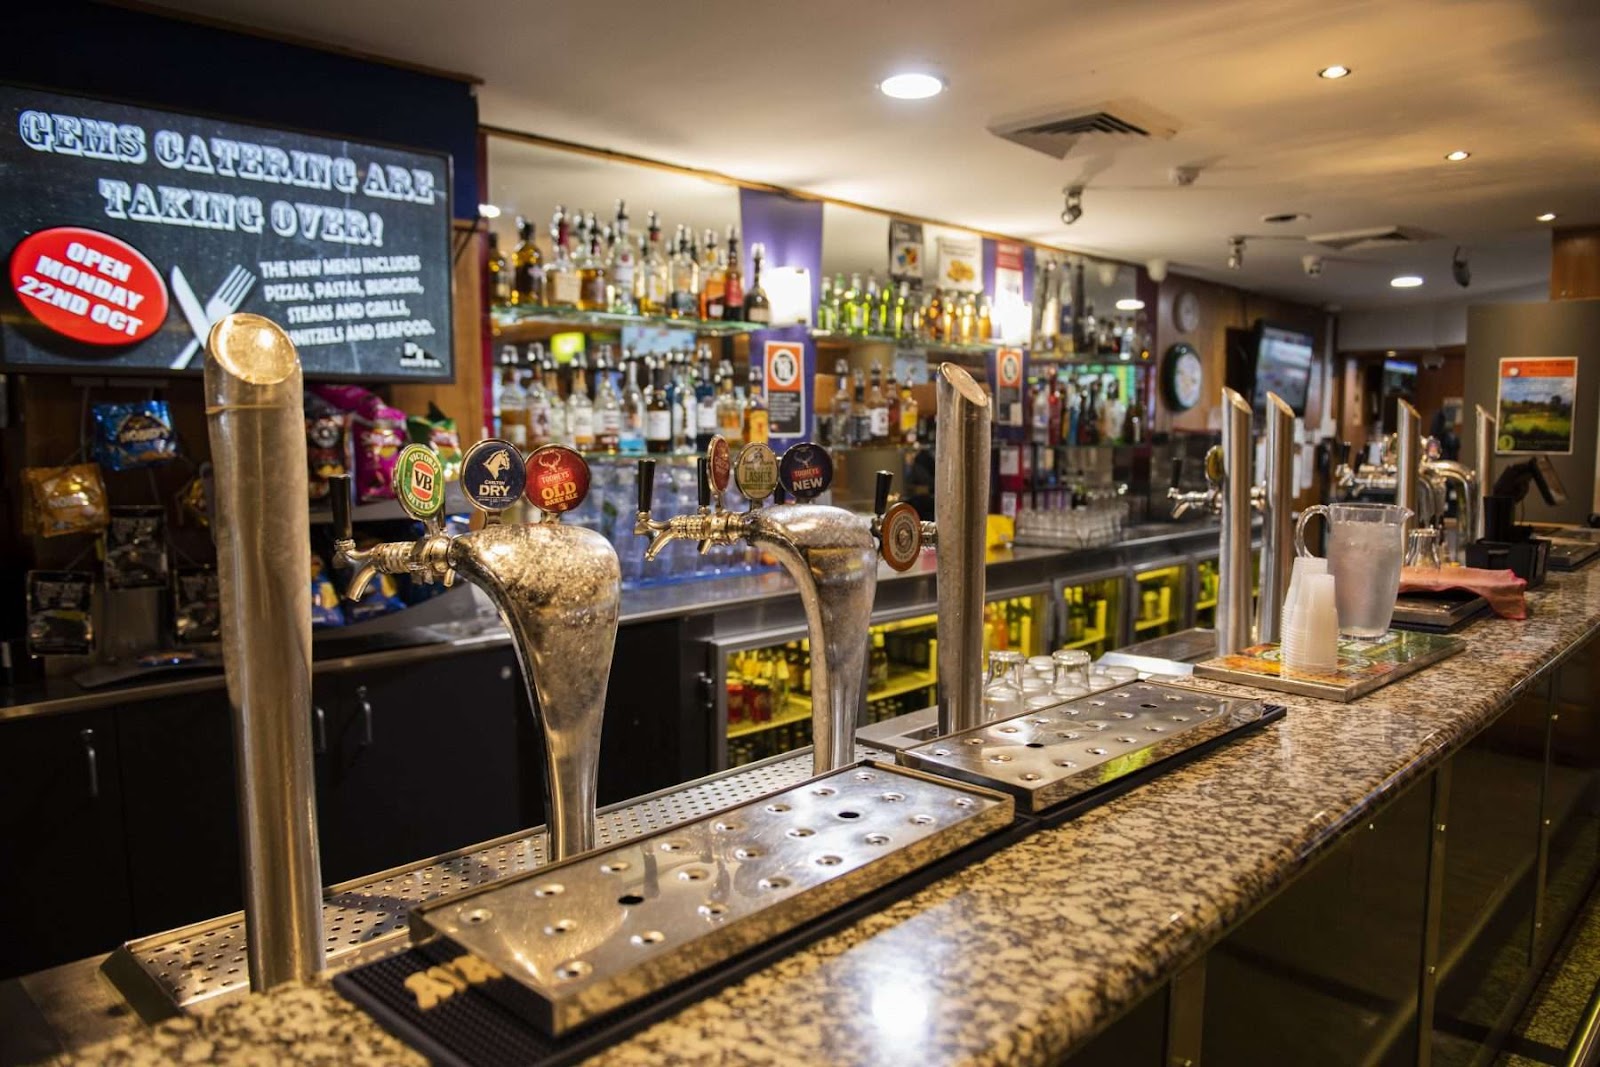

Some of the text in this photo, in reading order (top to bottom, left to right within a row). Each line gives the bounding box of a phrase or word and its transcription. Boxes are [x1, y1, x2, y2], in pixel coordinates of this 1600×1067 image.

[19, 110, 434, 205] GEMS CATERING ARE
[99, 178, 384, 248] TAKING OVER!
[66, 242, 132, 283] OPEN
[259, 255, 421, 279] THE NEW MENU INCLUDES
[35, 255, 144, 311] MONDAY
[264, 276, 425, 301] PIZZAS, PASTAS, BURGERS,
[18, 275, 143, 336] 22ND OCT
[287, 304, 334, 323] STEAKS
[335, 302, 365, 319] AND
[346, 324, 375, 341] AND
[409, 452, 440, 475] VICTORIA
[414, 470, 433, 492] VB
[479, 485, 511, 496] DRY
[541, 481, 577, 500] OLD
[792, 477, 822, 492] NEW
[407, 492, 435, 508] BITTER
